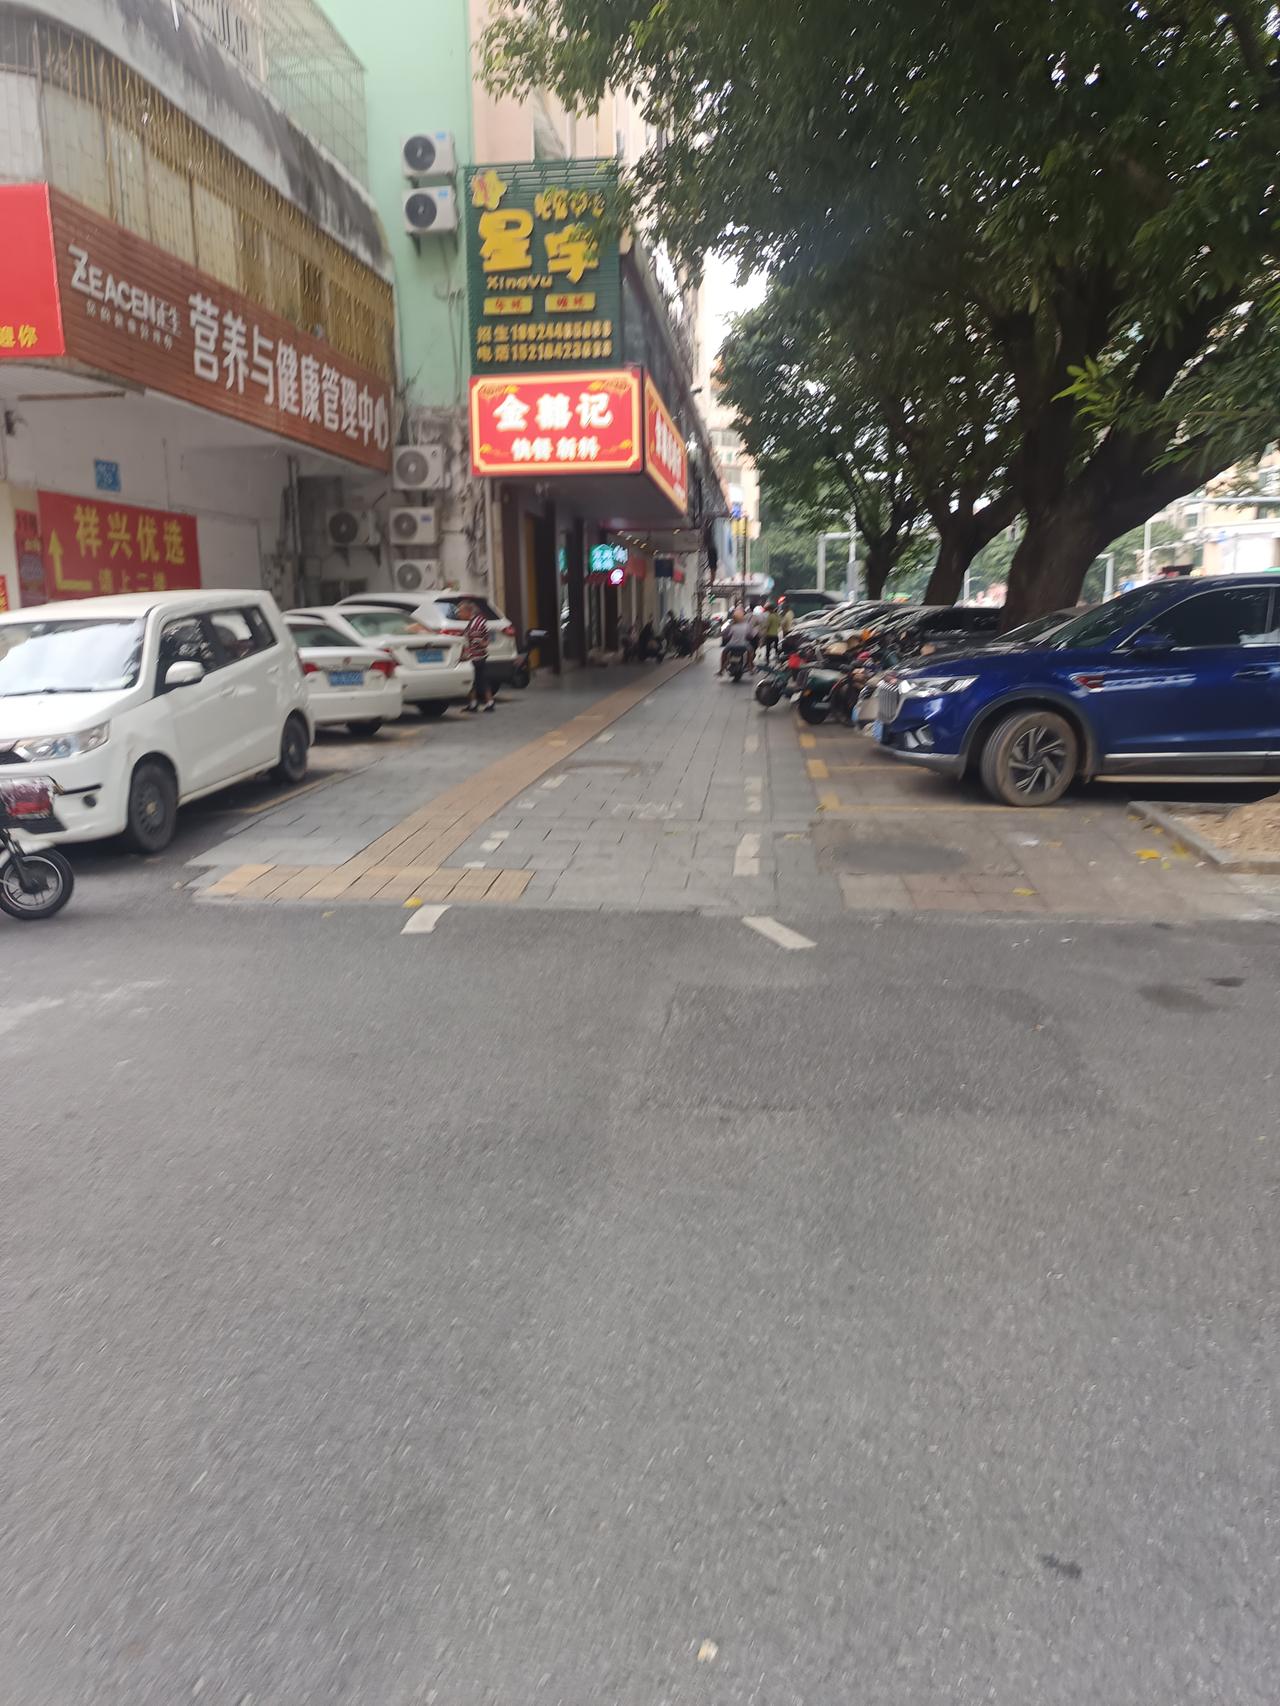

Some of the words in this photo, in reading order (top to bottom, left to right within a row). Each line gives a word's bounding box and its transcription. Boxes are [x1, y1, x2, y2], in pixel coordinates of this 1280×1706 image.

[68, 244, 156, 326] ZEACEN
[188, 292, 390, 451] 营养与健康管理中心
[74, 504, 185, 565] 祥兴优选
